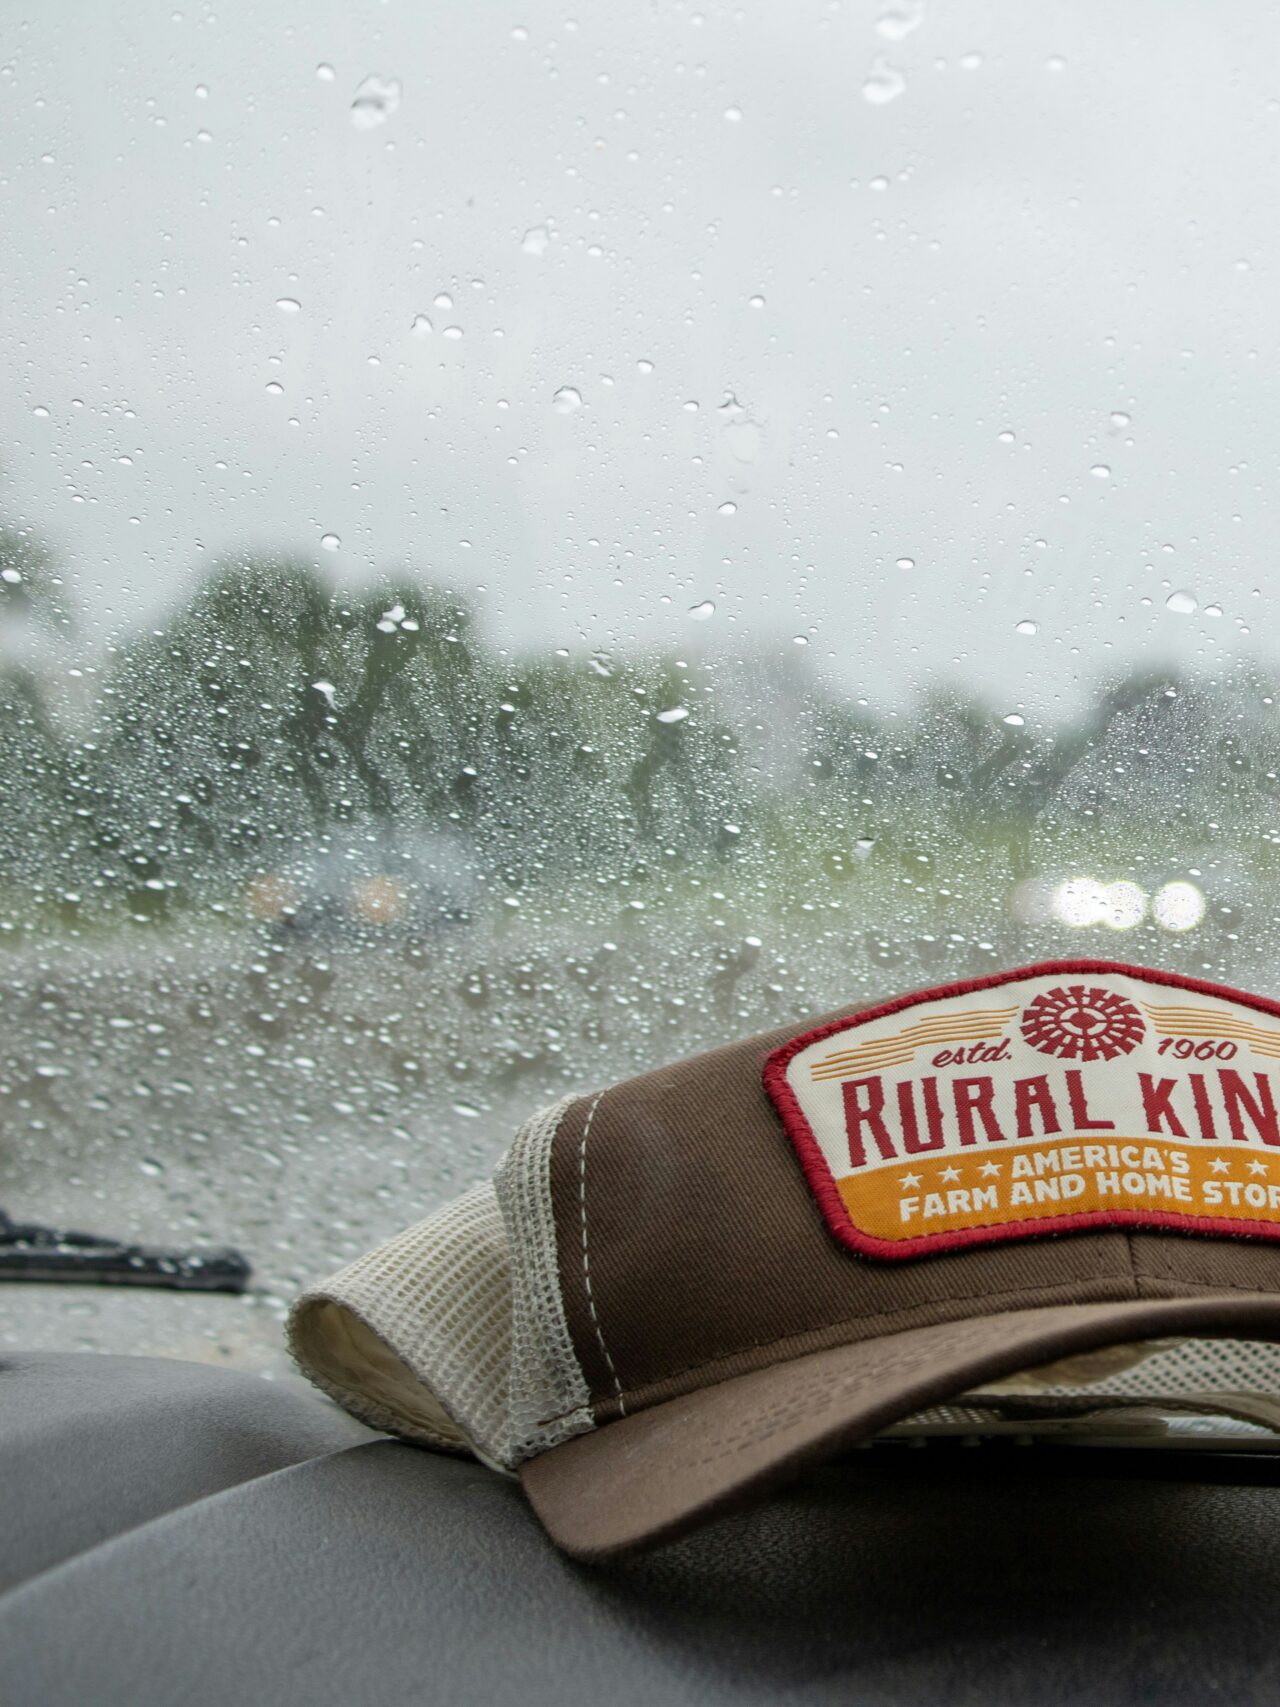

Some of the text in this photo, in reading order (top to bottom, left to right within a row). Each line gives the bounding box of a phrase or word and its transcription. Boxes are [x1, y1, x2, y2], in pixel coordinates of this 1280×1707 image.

[932, 1036, 1238, 1068] estd. 1960
[841, 1069, 1115, 1168] RURAL
[1011, 1144, 1190, 1178] AMERICA'S
[900, 1182, 999, 1222] FARM
[1010, 1173, 1087, 1206] AND
[1097, 1172, 1192, 1202] HOME
